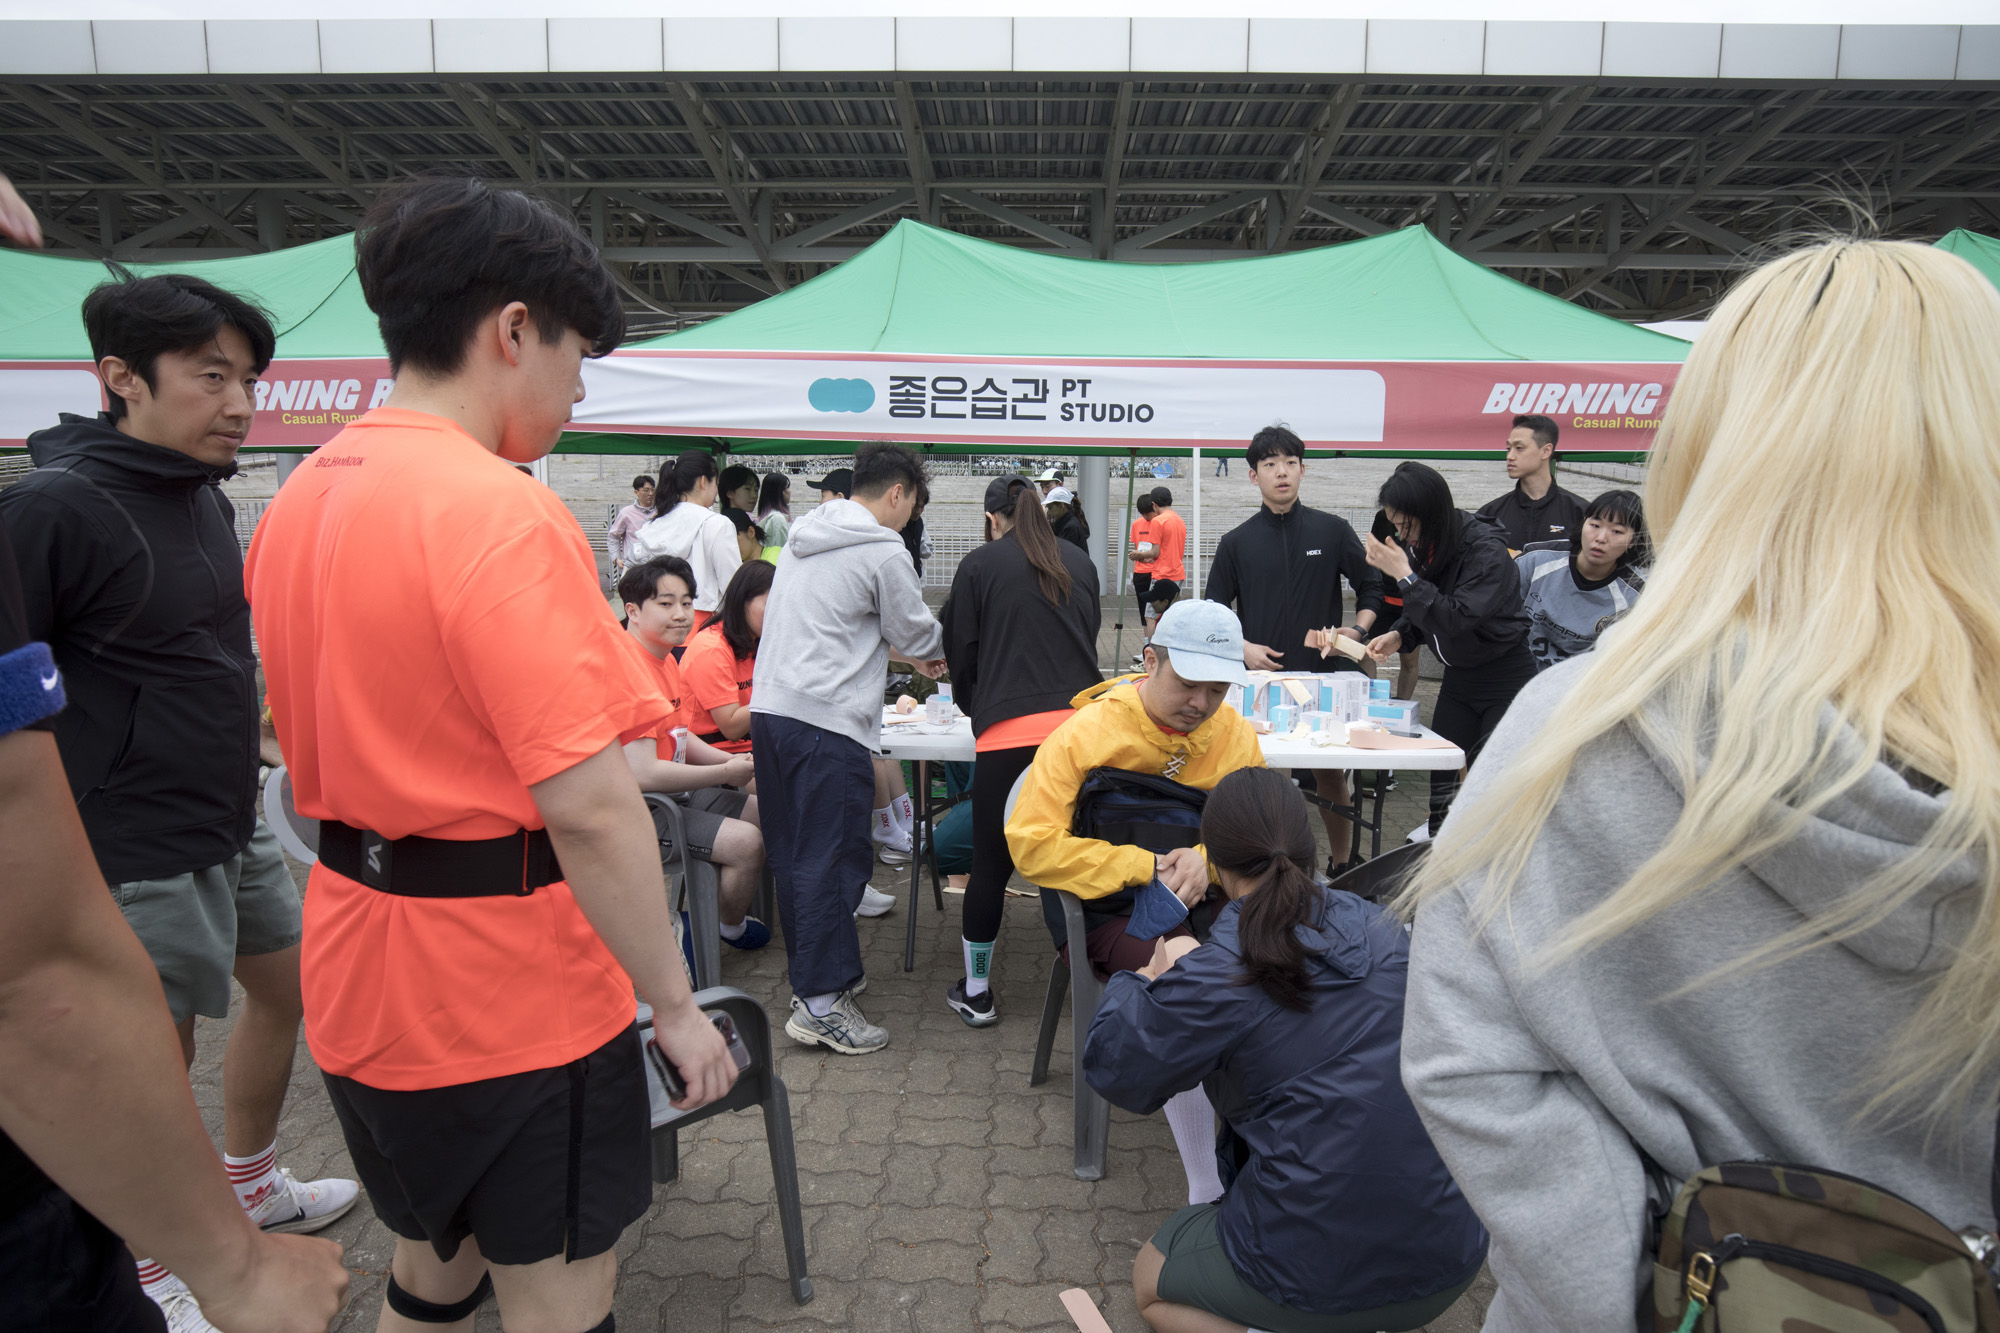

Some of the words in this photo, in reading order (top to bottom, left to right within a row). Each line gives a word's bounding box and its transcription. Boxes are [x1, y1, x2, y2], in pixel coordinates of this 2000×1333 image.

[254, 378, 362, 411] RNING
[888, 375, 1050, 421] 좋은습관
[1061, 378, 1092, 398] PT
[1481, 382, 1663, 415] BURNING
[282, 412, 327, 425] Casual
[1060, 402, 1154, 423] STUDIO
[1573, 416, 1621, 429] Casual
[1624, 416, 1662, 429] Runn
[976, 952, 987, 975] GOOD
